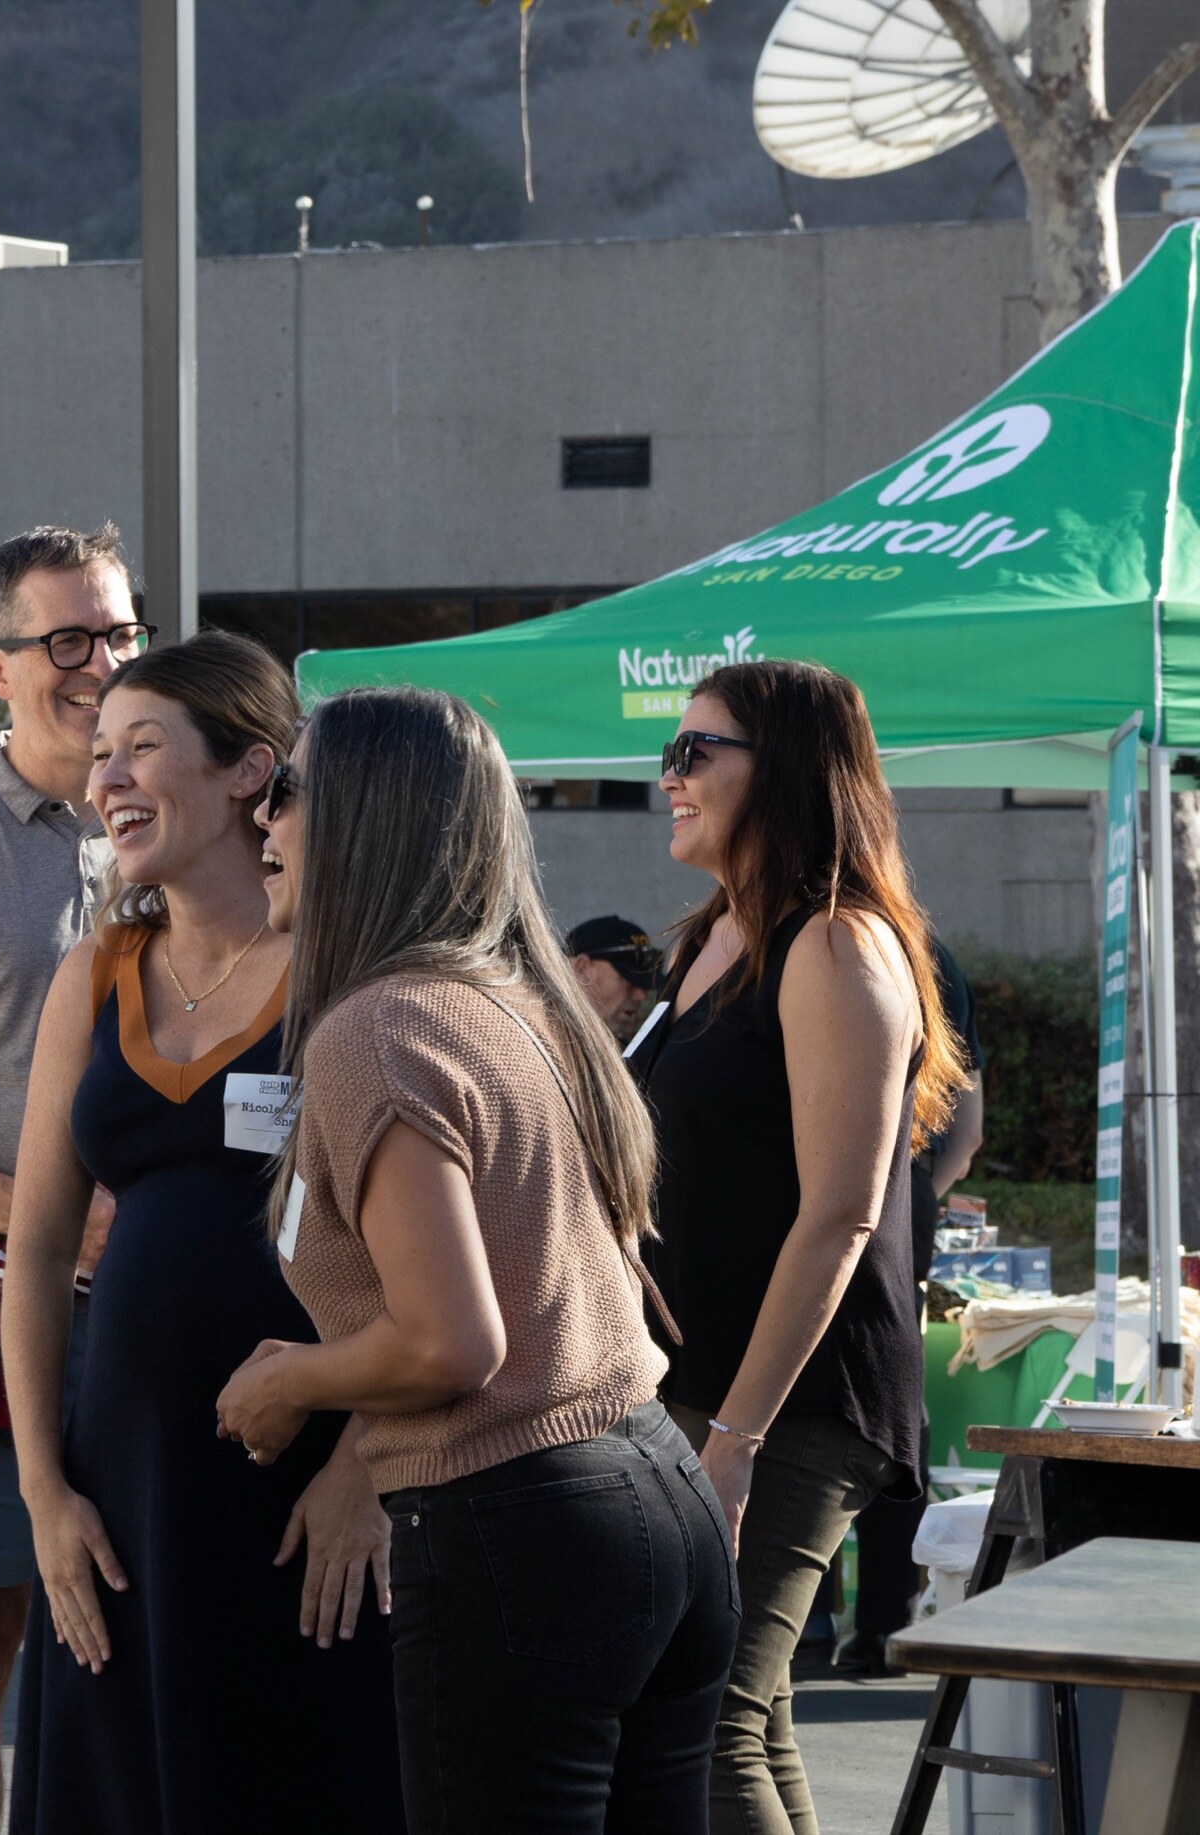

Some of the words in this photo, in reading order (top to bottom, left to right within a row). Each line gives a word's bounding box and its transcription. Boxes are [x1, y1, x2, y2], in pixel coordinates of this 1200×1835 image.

[702, 565, 780, 586] SAN
[781, 563, 903, 581] DIEGO
[642, 697, 672, 714] SAN
[241, 1101, 280, 1114] Nicole
